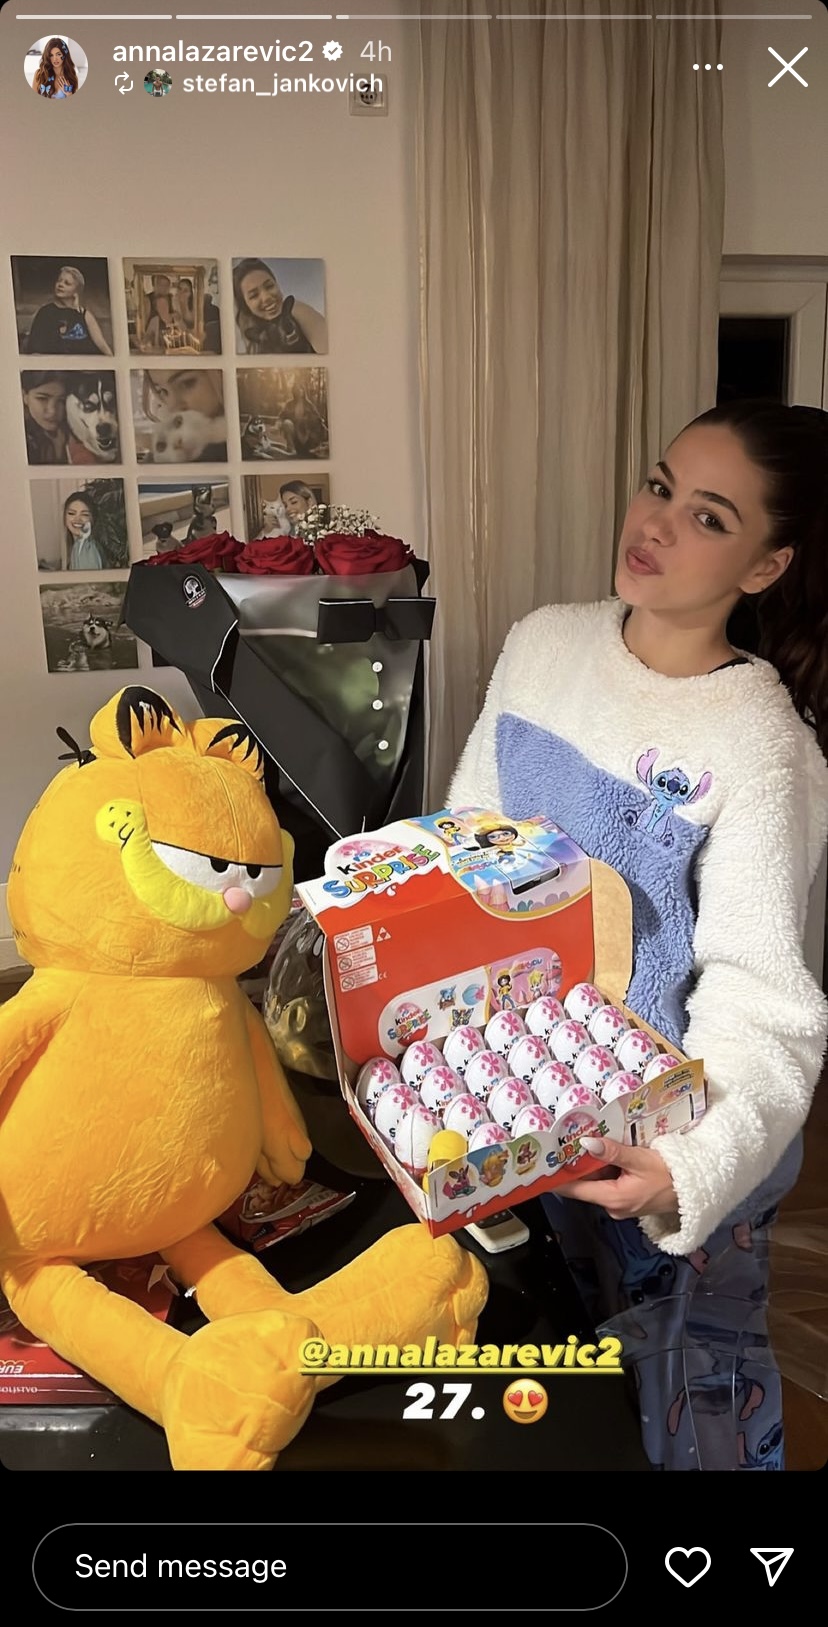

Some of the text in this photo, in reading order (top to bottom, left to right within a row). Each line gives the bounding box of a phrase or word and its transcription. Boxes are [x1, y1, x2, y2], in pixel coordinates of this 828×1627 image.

[322, 843, 441, 899] SURPRISE
[337, 845, 403, 876] kinder
[394, 1008, 421, 1026] kinder
[558, 1119, 595, 1147] kinder
